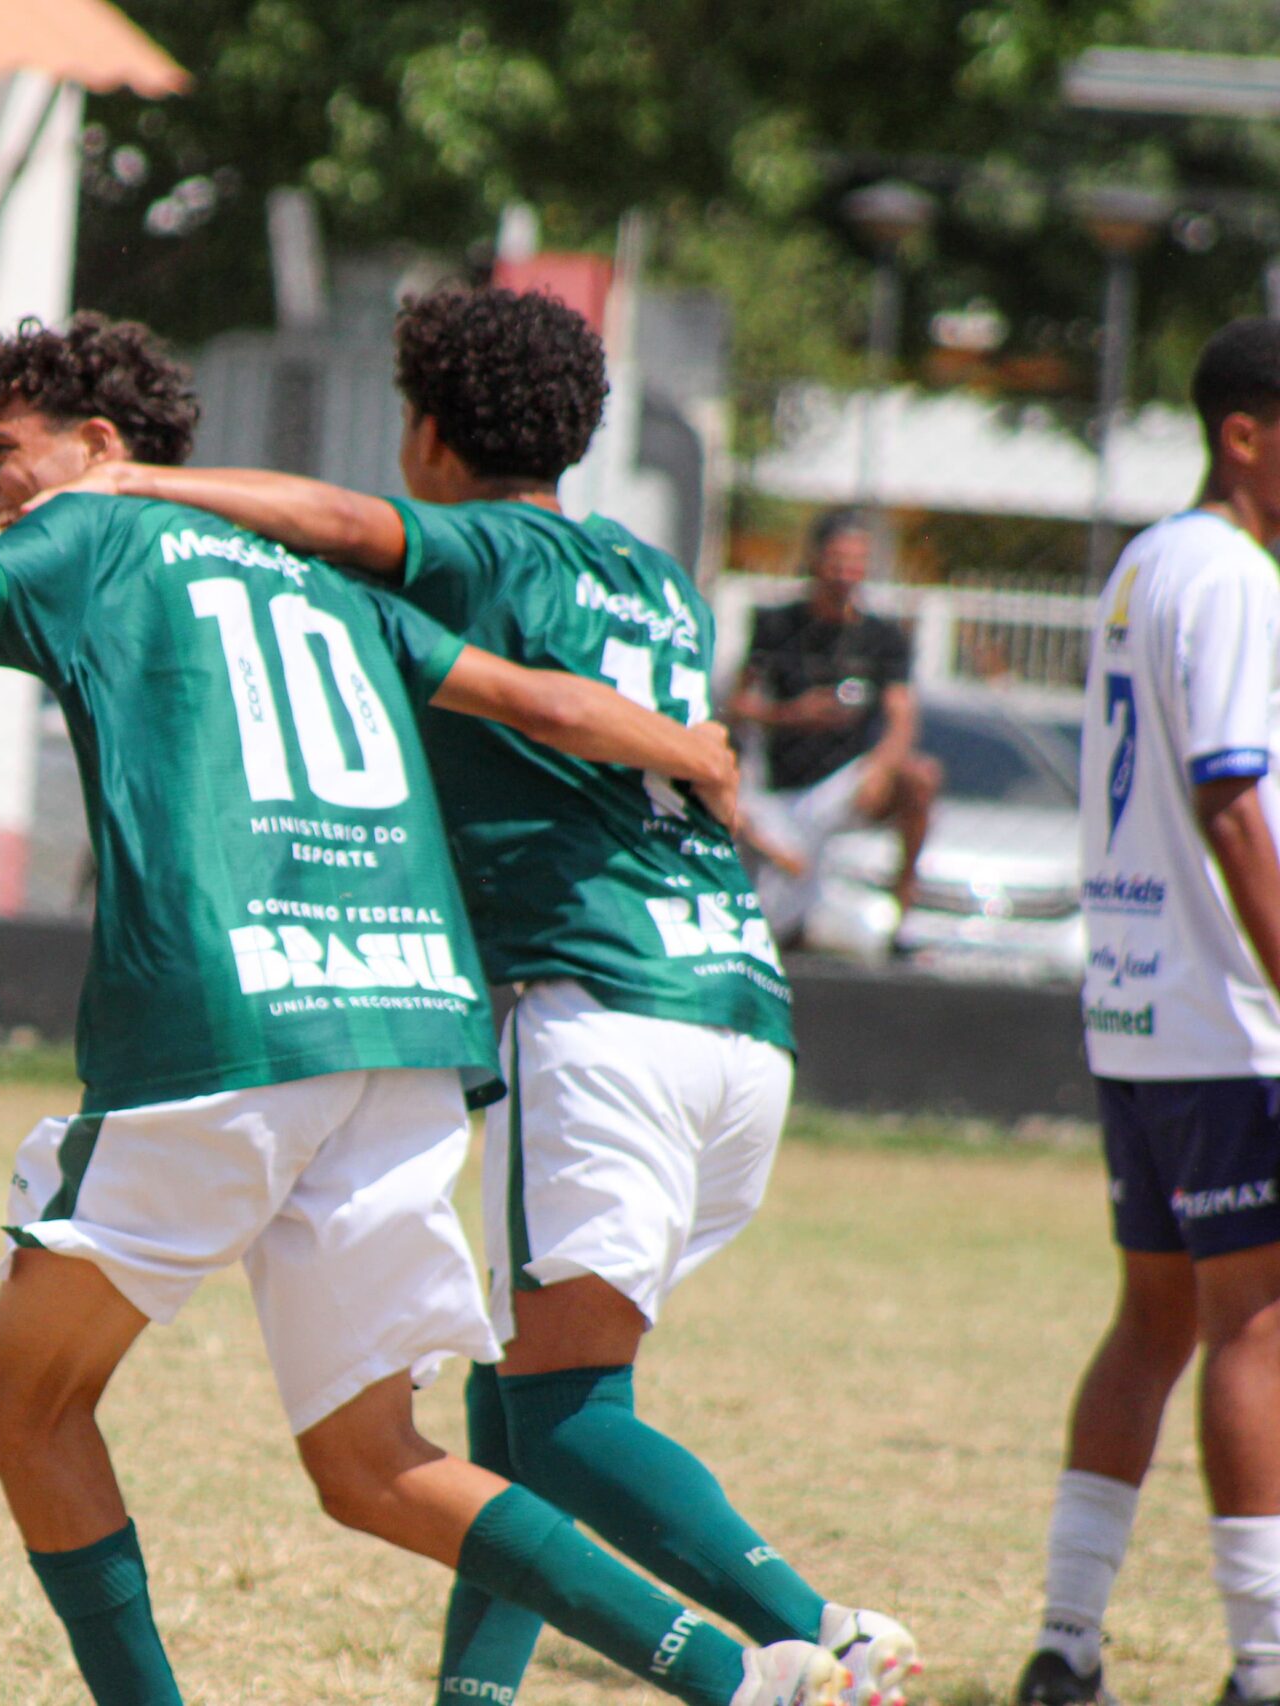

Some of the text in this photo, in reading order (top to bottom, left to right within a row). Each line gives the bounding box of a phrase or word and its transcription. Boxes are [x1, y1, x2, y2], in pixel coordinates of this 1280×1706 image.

[186, 576, 411, 809] 10
[373, 826, 408, 844] DO
[292, 843, 379, 868] ESPORTE
[247, 898, 444, 925] GOVERNO FEDERAL
[228, 924, 479, 996] BRASIL
[269, 995, 328, 1016] UNIÃO
[332, 997, 344, 1009] E
